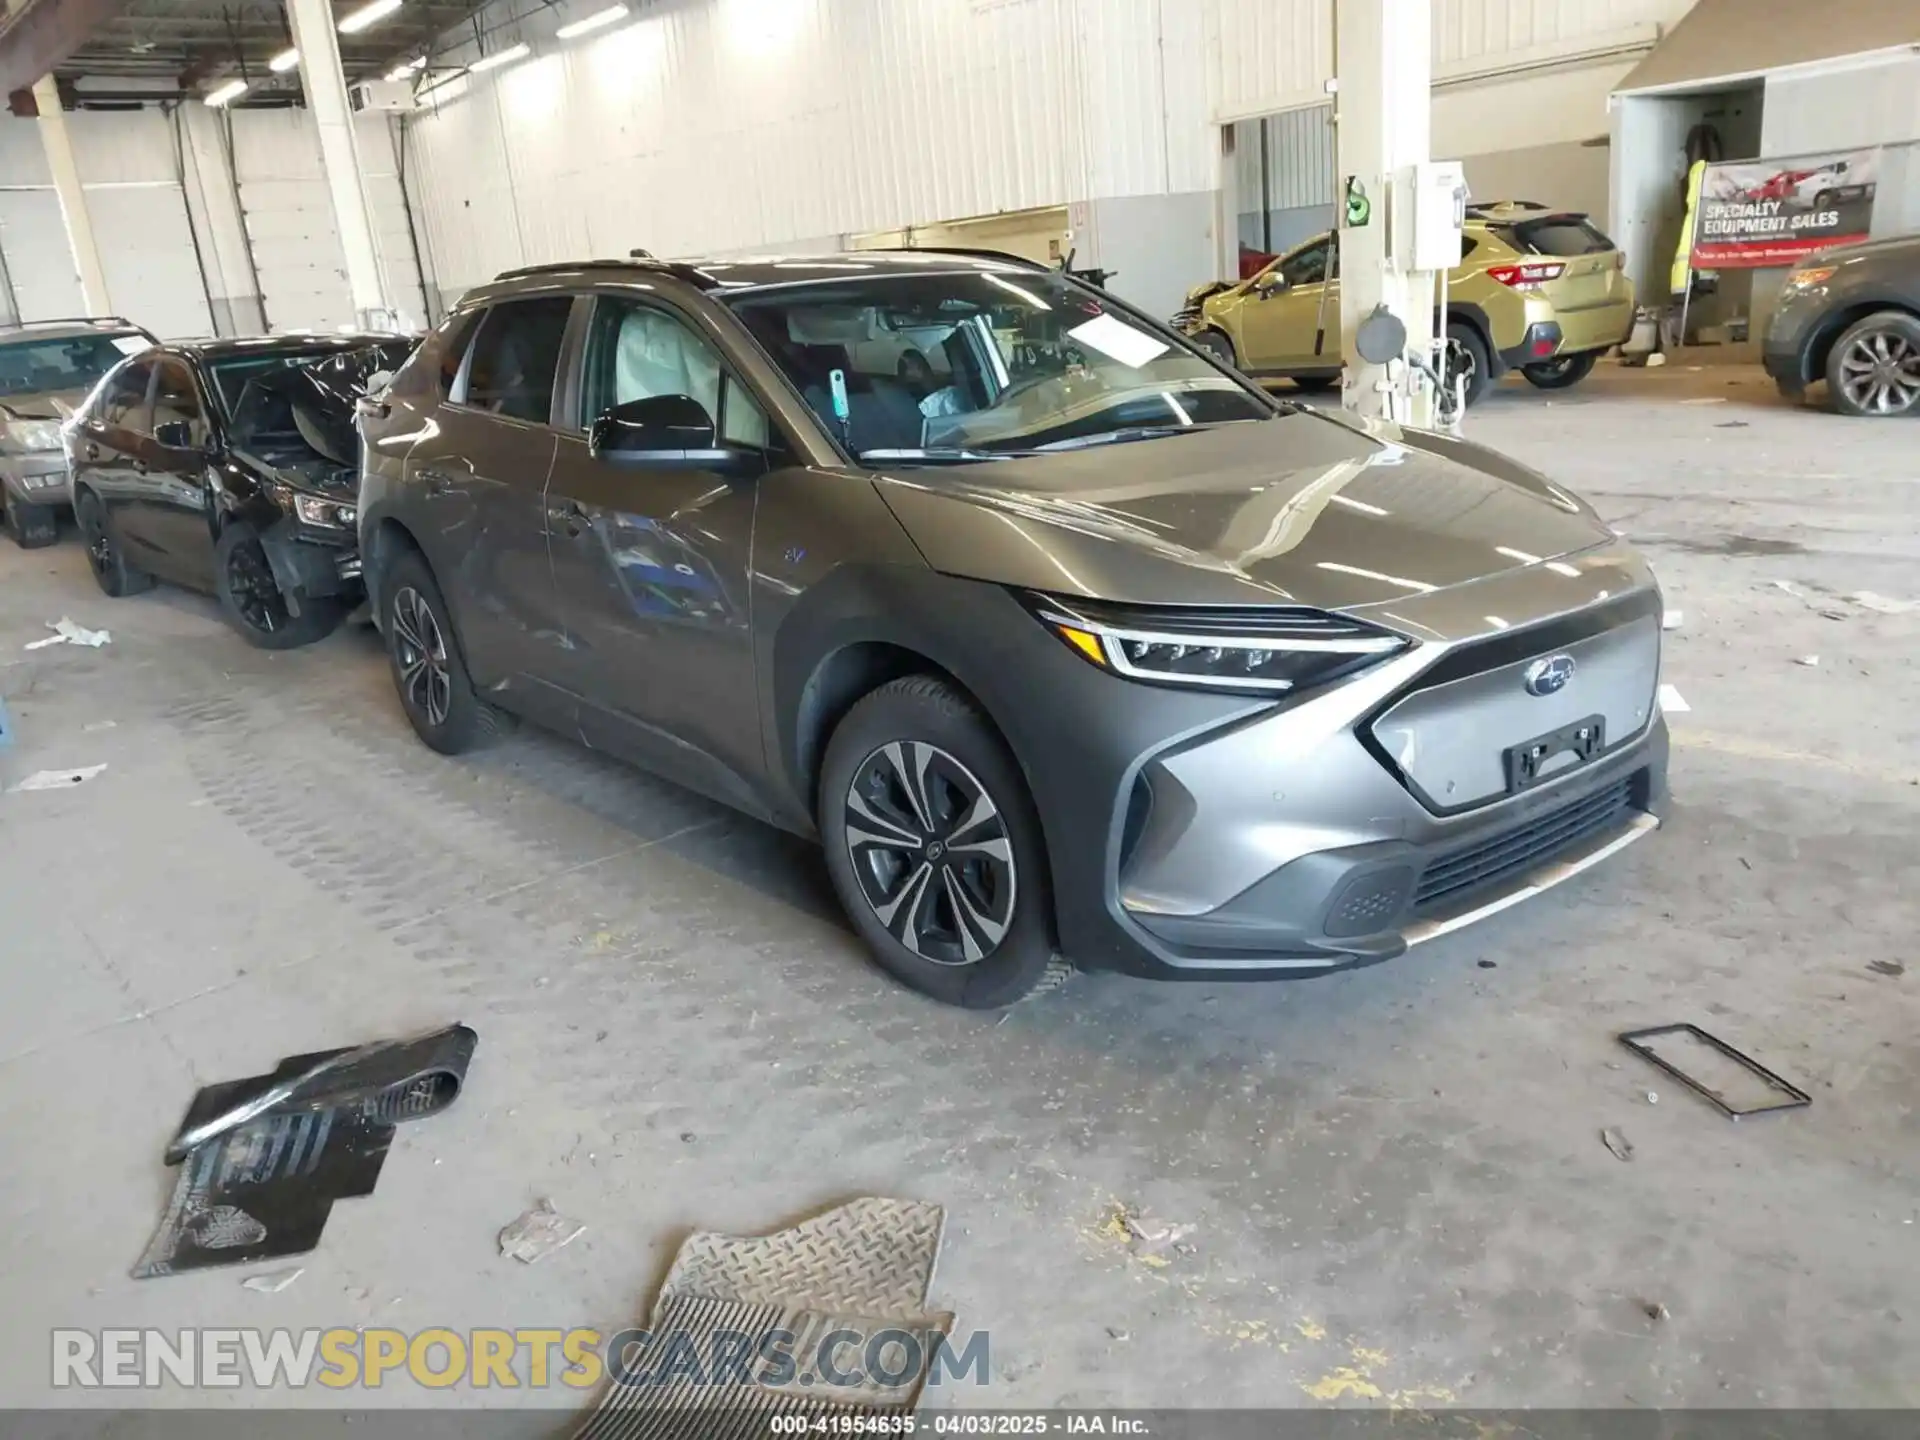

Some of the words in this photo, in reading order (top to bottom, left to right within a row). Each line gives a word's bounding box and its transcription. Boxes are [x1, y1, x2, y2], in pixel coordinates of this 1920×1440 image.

[1705, 201, 1781, 219] SPECIALTY
[1704, 217, 1788, 234] EQUIPMENT
[1790, 211, 1839, 229] SALES
